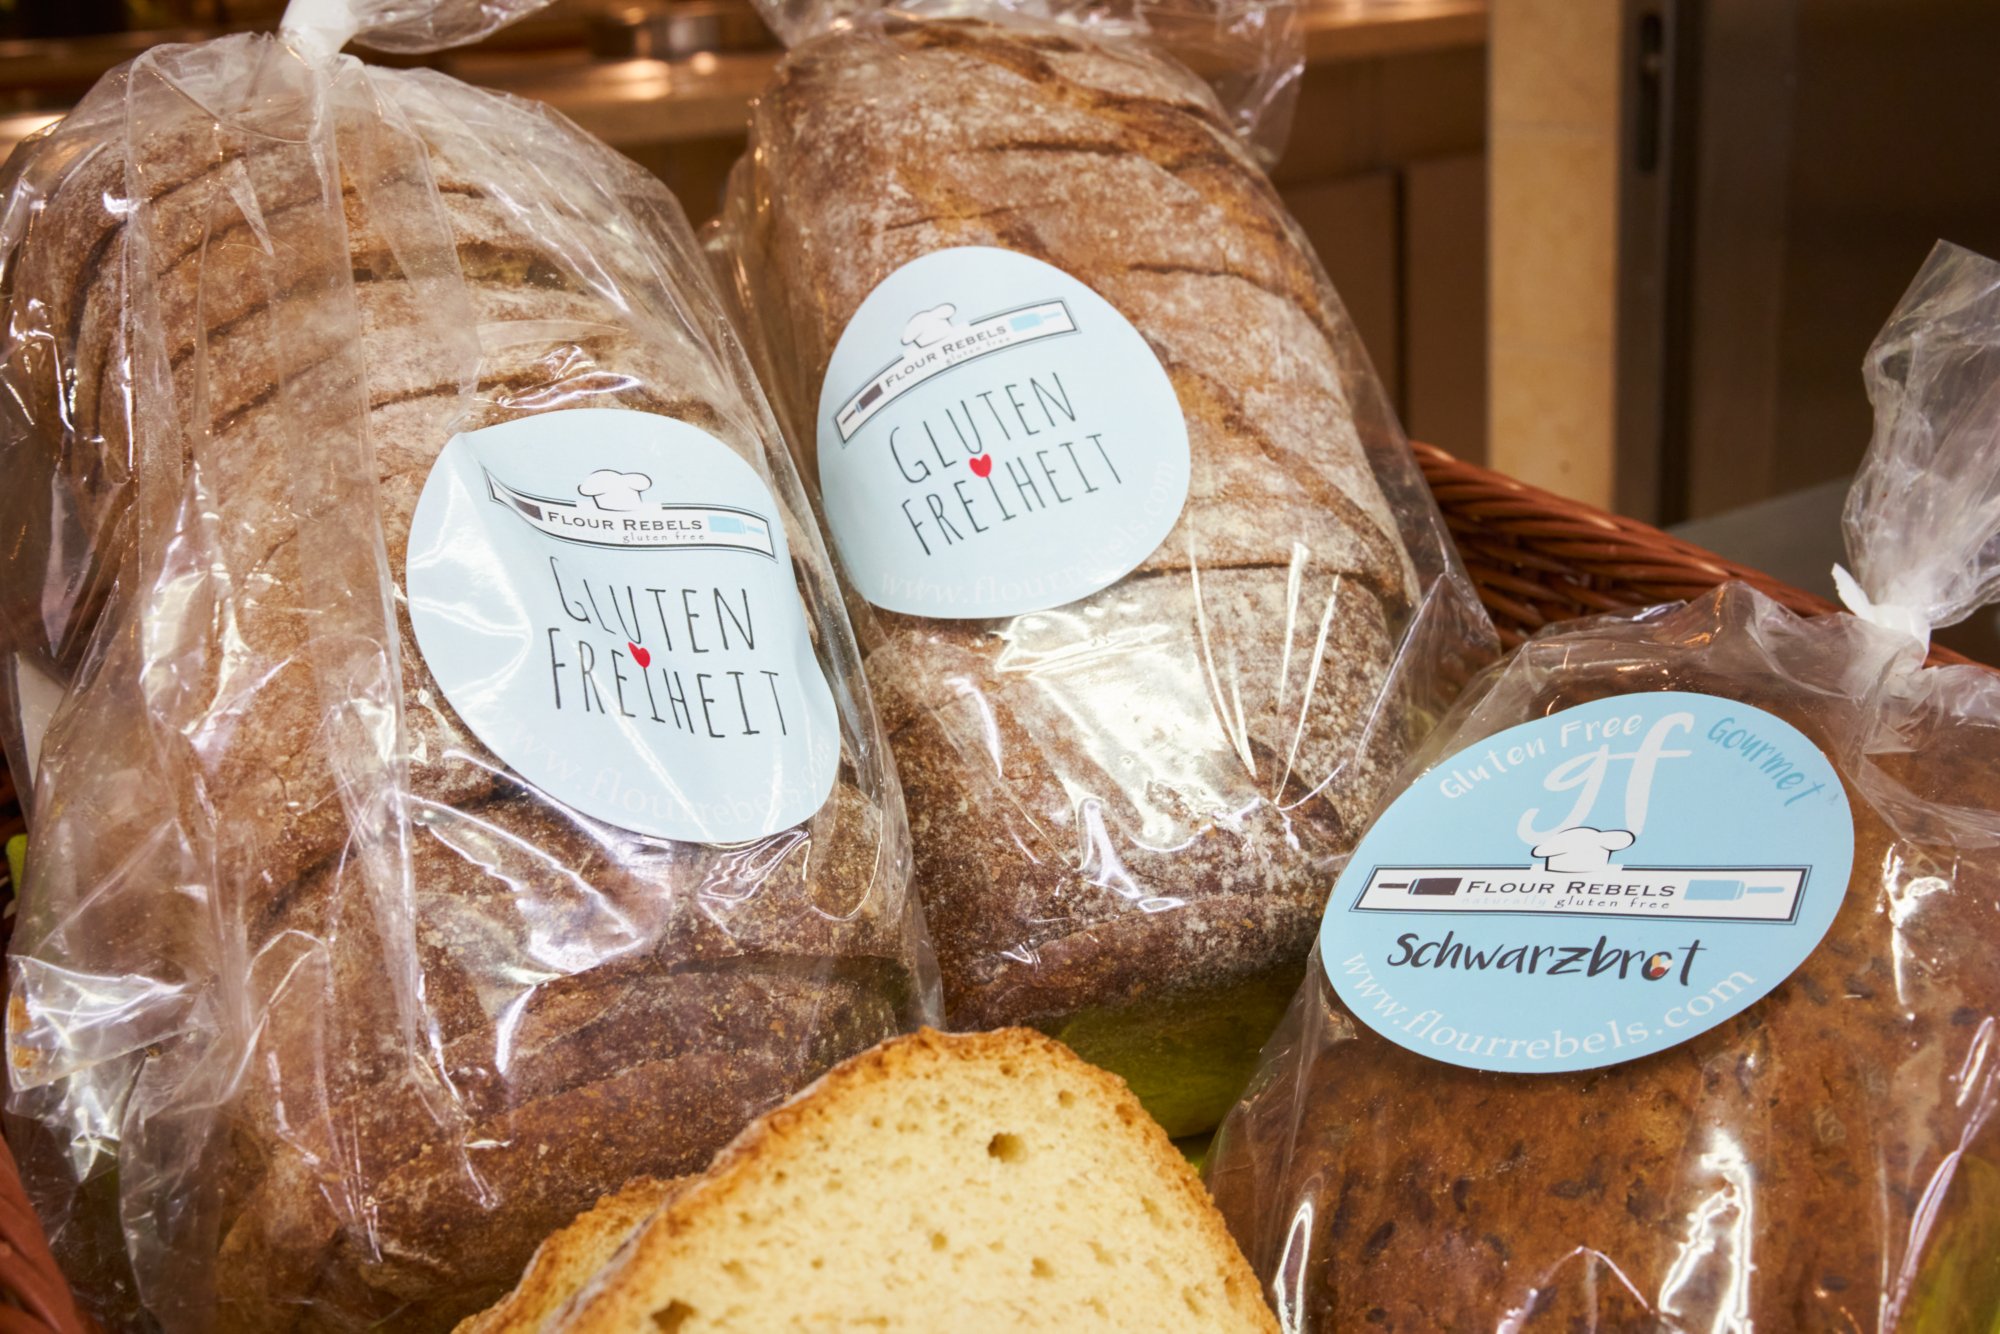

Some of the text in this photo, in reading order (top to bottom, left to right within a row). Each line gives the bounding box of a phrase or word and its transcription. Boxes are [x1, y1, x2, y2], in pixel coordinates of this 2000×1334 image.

[884, 325, 1008, 388] FLOUR REBELS
[889, 372, 1076, 484] GLUTEN
[548, 511, 703, 531] FLOUR REBELS
[622, 532, 668, 544] gluten
[675, 531, 705, 542] free
[902, 433, 1122, 556] FREIHEIT
[549, 556, 755, 653] GLUTEN
[548, 628, 787, 738] FREIHEIT
[1439, 713, 1643, 799] Gluten Free
[1707, 717, 1825, 807] Gourmet
[1466, 880, 1676, 898] FLOUR REBELS
[1553, 896, 1619, 909] gluten
[1629, 897, 1671, 909] free
[1386, 930, 1708, 987] Schwarzbrot
[1341, 952, 1758, 1060] www.flourrebels.com
